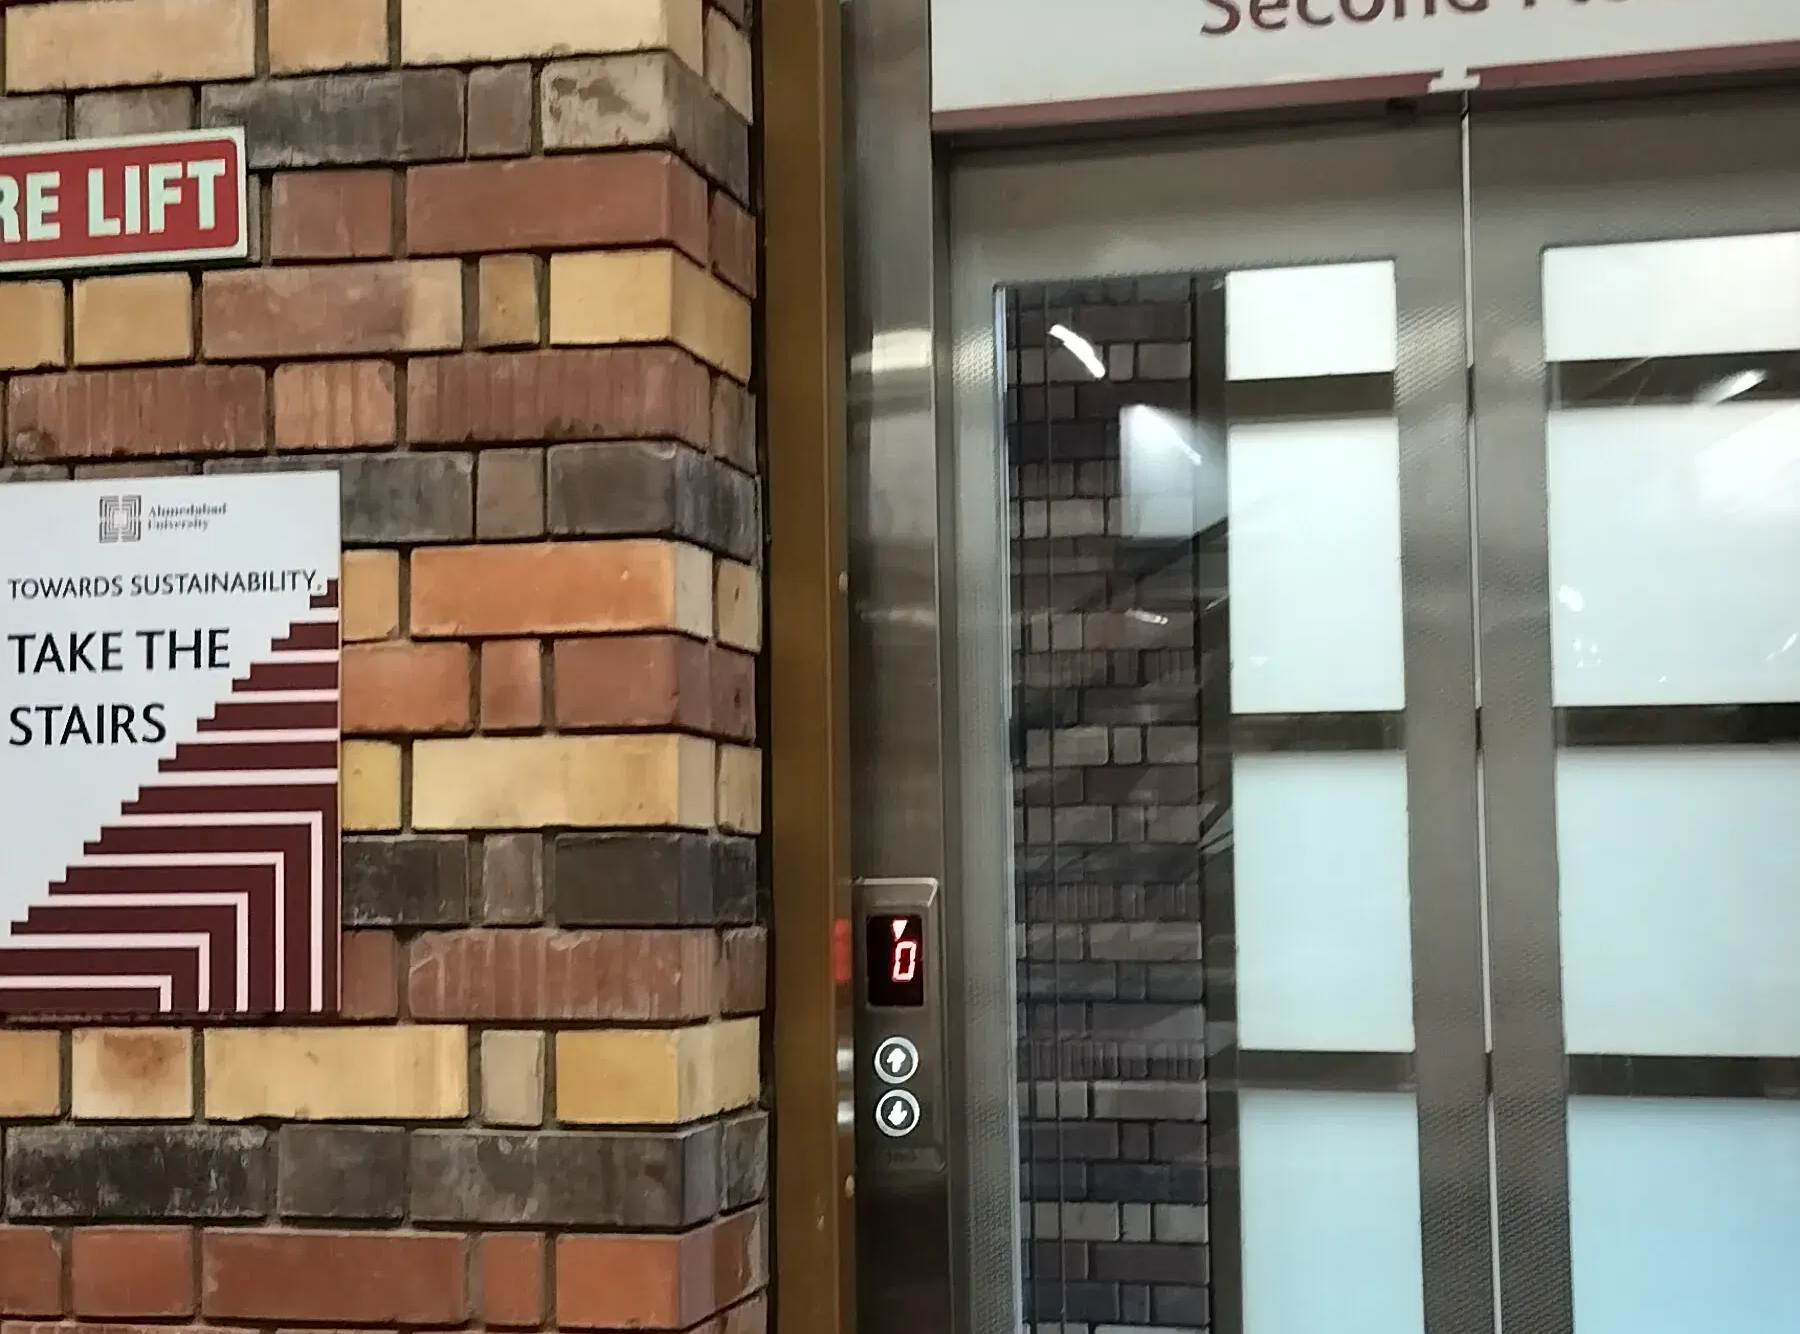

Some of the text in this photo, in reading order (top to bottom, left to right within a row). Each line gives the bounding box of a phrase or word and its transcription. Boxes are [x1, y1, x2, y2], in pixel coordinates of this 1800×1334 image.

[87, 159, 226, 237] LIFT
[8, 575, 123, 600] TOWARDS
[8, 627, 231, 674] TAKE THE
[9, 702, 166, 746] STAIRS
